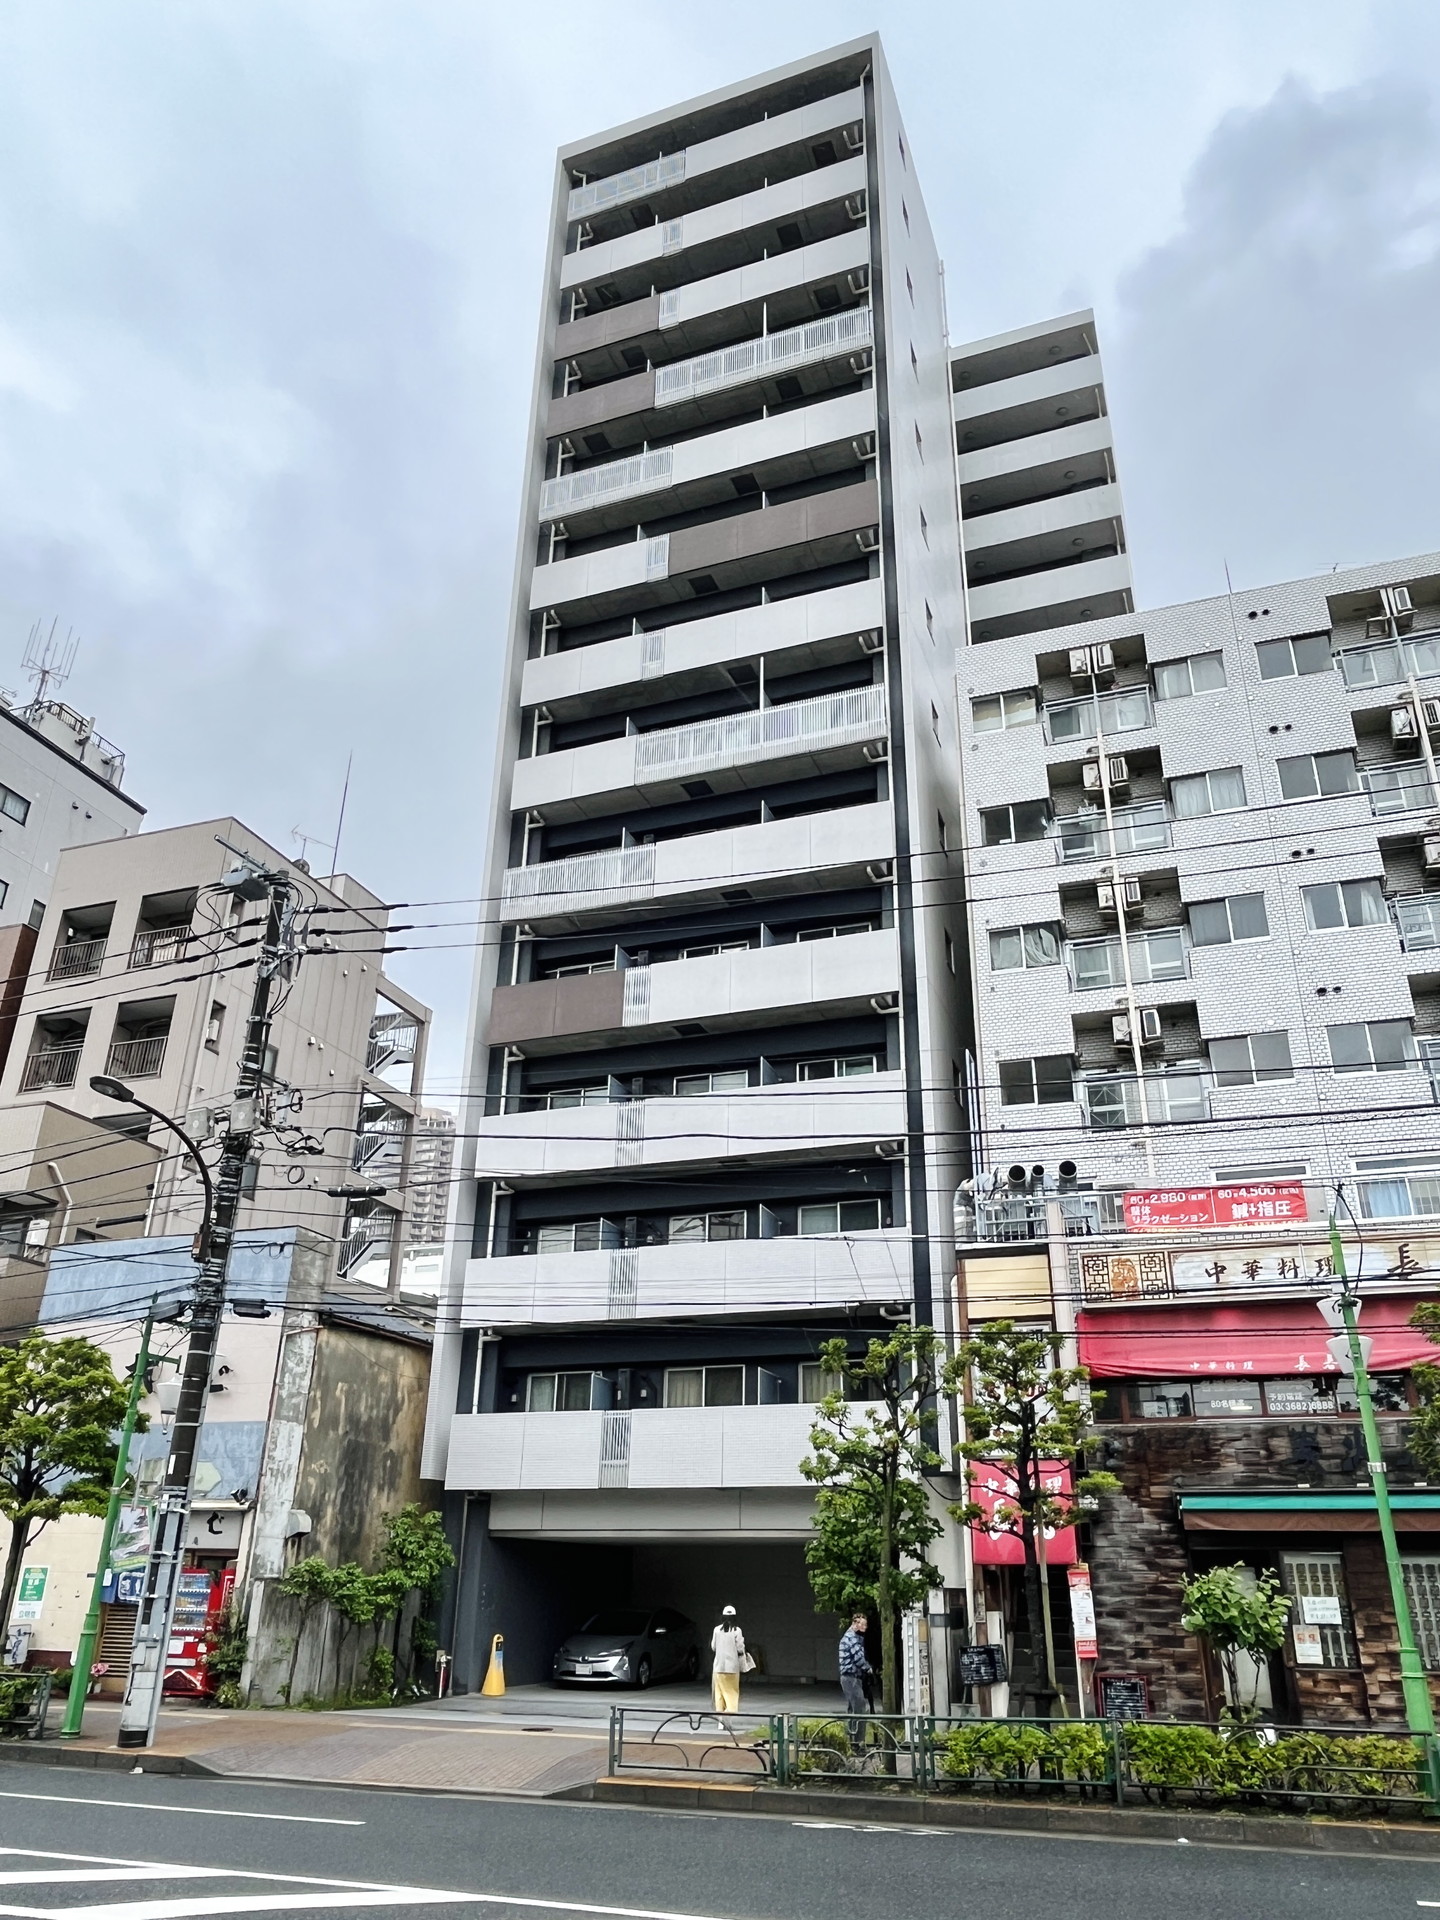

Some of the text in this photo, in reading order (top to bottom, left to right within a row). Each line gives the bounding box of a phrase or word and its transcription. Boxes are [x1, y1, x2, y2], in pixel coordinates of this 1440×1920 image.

[1132, 1212, 1209, 1225] リラクゼーション
[1205, 1255, 1335, 1284] 中華料理
[1190, 1361, 1254, 1371] 中華料理
[981, 1475, 1063, 1497] 中華理
